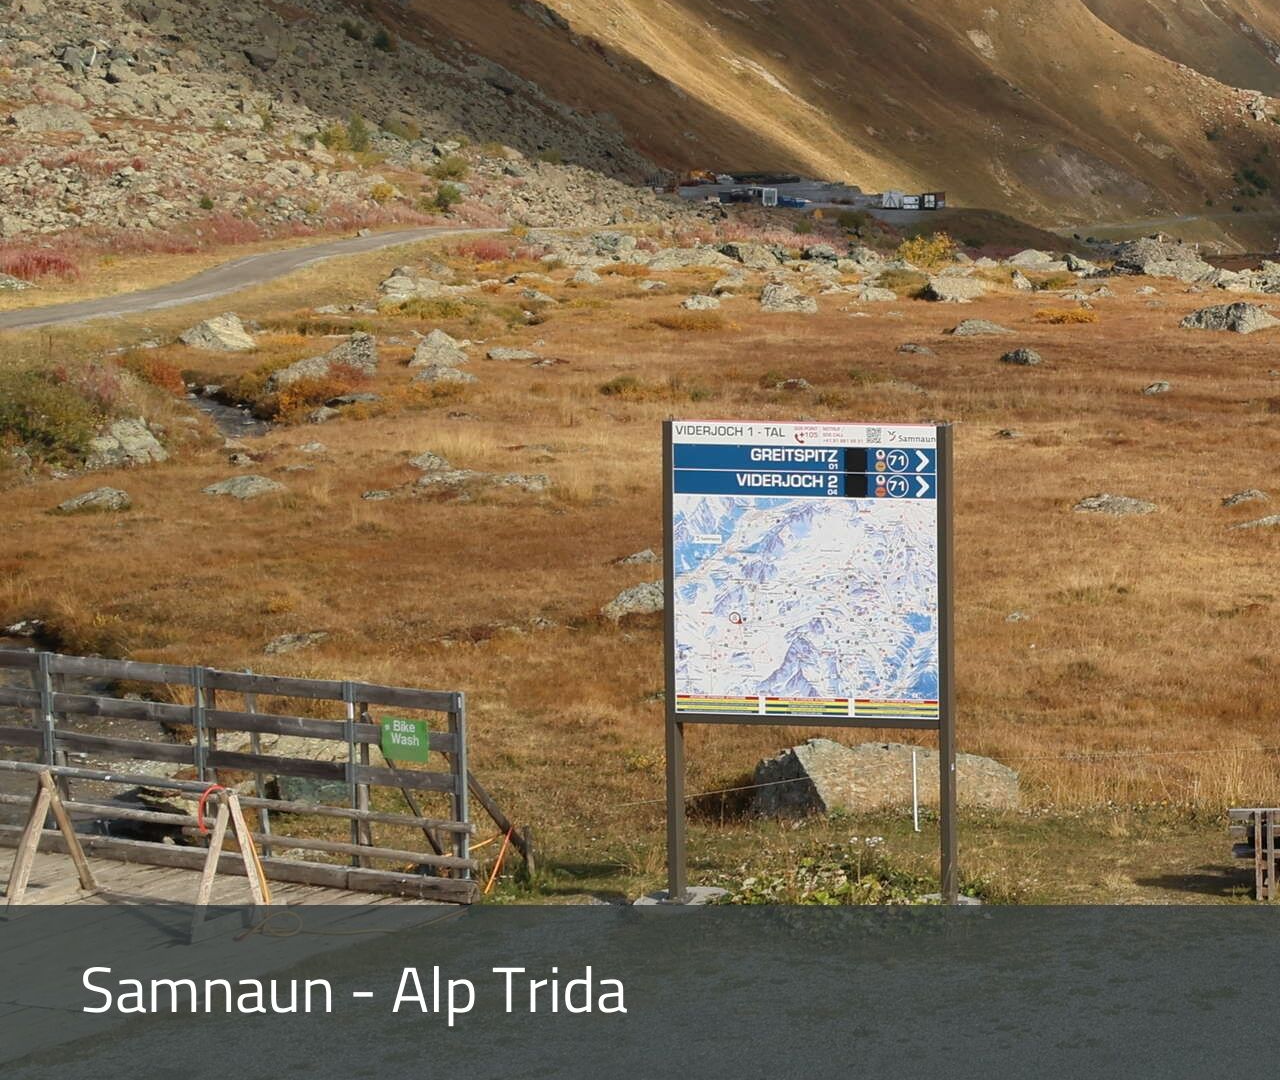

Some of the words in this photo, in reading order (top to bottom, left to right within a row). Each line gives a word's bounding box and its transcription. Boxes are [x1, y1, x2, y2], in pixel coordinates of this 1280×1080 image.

[675, 425, 743, 437] VIDERJOCH
[747, 427, 754, 437] 1
[764, 427, 786, 438] TAL
[898, 434, 937, 443] Samnaun
[750, 448, 838, 463] GREITSPITZ
[889, 454, 906, 467] 71
[736, 473, 824, 489] VIDERJOCH
[827, 475, 838, 489] 2
[889, 480, 906, 492] 71
[393, 720, 416, 733] Bike
[391, 732, 420, 747] Wash
